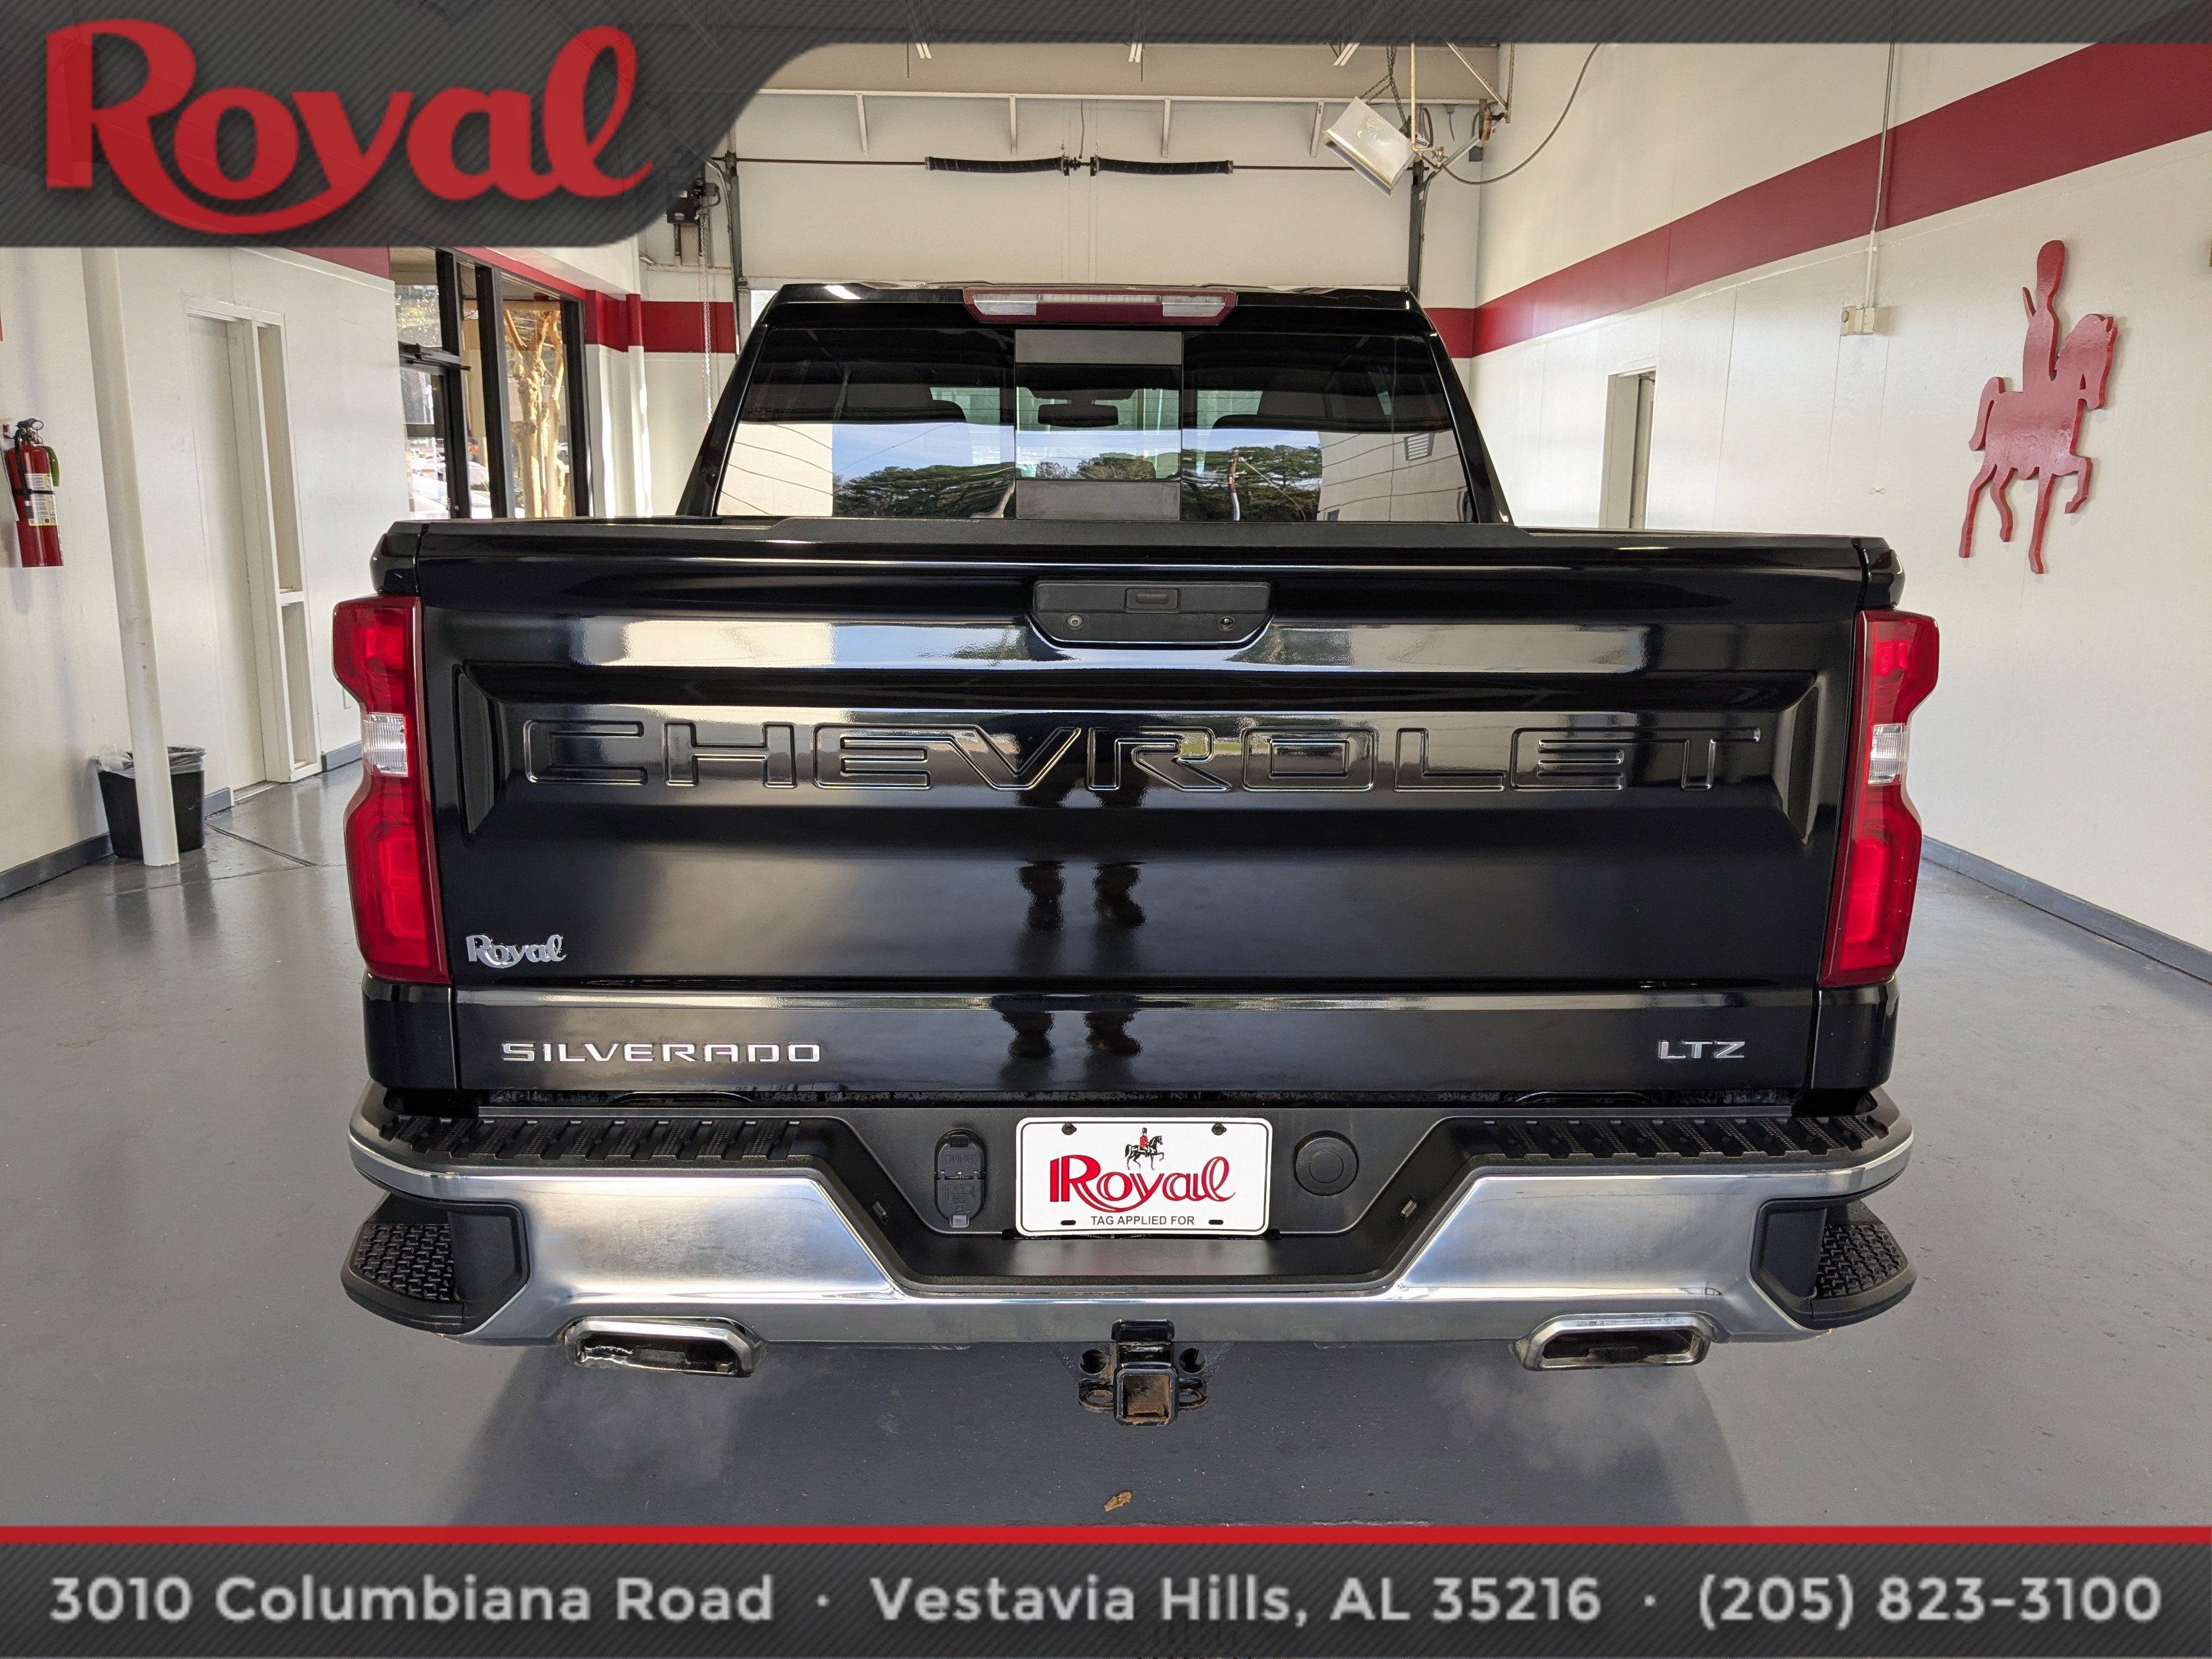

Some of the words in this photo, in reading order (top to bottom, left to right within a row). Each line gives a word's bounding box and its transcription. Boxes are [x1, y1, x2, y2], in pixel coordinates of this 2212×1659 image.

[522, 719, 1761, 791] CHEVROLET
[466, 934, 568, 969] Royal
[501, 1042, 821, 1063] SILVERADO
[1657, 1040, 1746, 1059] LTZ
[1049, 1154, 1236, 1213] Royal
[1091, 1216, 1114, 1225] TAG
[1117, 1216, 1167, 1225] APPLIED
[1170, 1216, 1195, 1226] FOR
